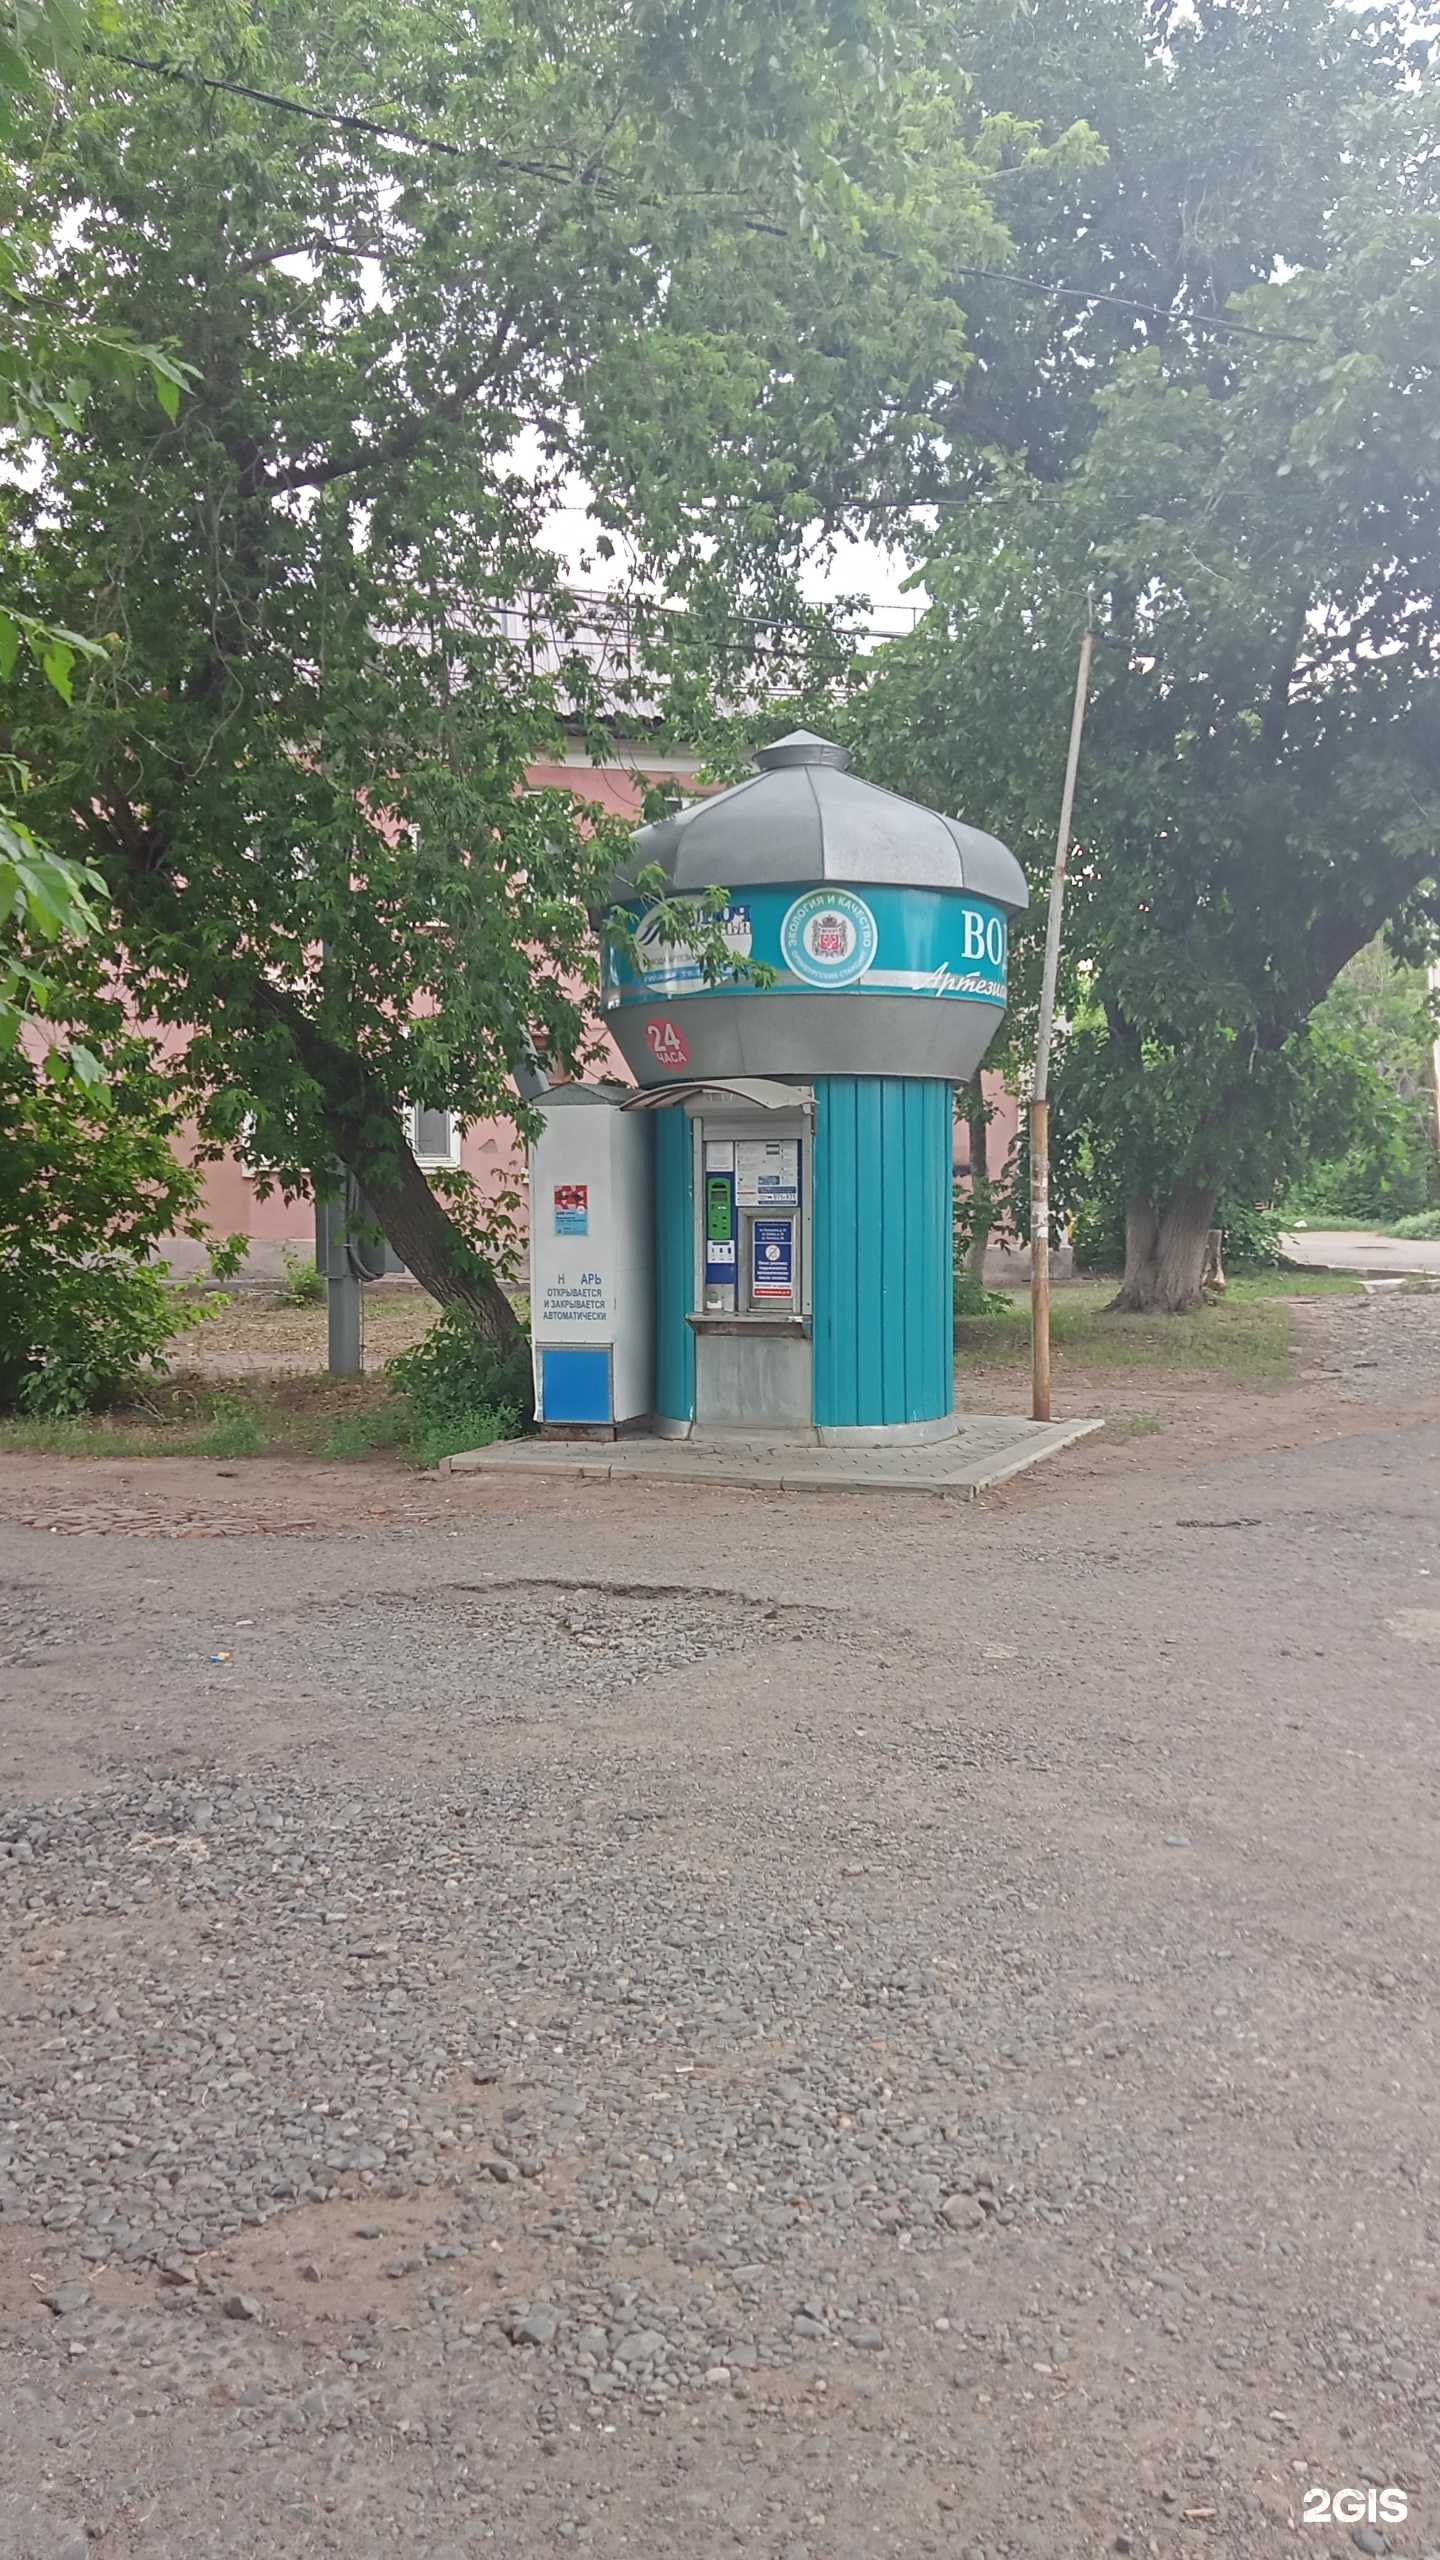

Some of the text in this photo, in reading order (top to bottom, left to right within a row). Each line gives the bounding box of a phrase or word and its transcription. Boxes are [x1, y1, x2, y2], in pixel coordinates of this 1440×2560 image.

[788, 894, 872, 948] ЭКОЛОГИЯ И КАЧЕСТВО
[960, 909, 1007, 966] ВО
[647, 1023, 680, 1052] 24
[656, 1051, 688, 1063] ЧАСА
[547, 1288, 602, 1298] ОТКРЫВАЕТСЯ
[543, 1300, 606, 1309] И ЗАКРЫВАЕТСЯ
[543, 1311, 607, 1321] АВТОМАТИЧЕСКИ
